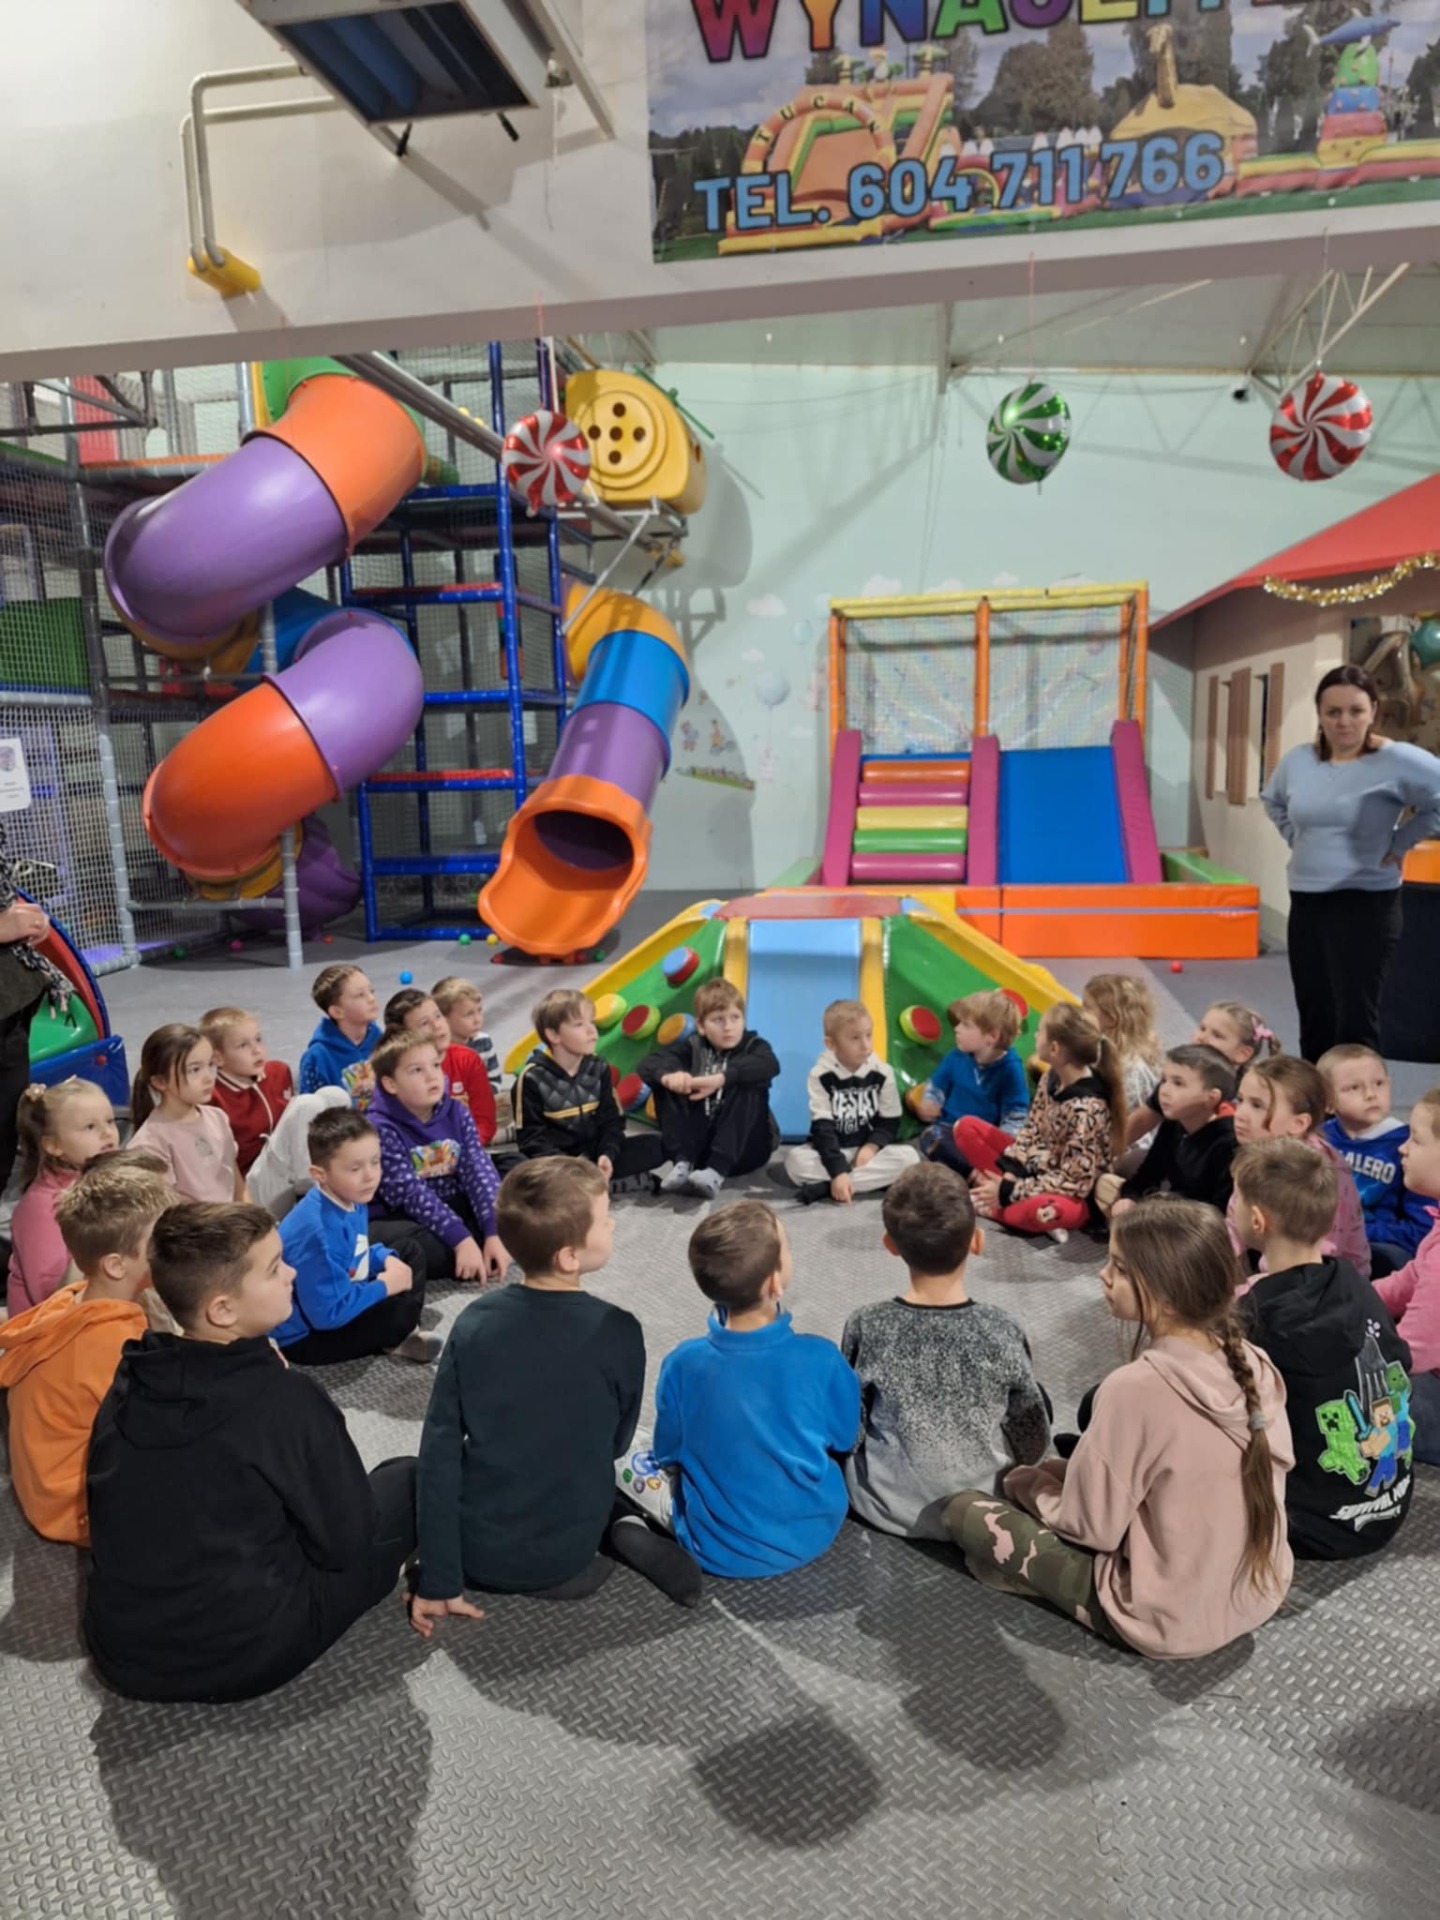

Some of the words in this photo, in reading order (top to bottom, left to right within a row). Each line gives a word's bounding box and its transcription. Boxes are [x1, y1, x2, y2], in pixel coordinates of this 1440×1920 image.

[692, 169, 832, 233] TEL.
[848, 155, 976, 222] 604
[990, 143, 1086, 210] 711
[1100, 131, 1226, 200] 766
[1339, 1150, 1397, 1184] ALERO
